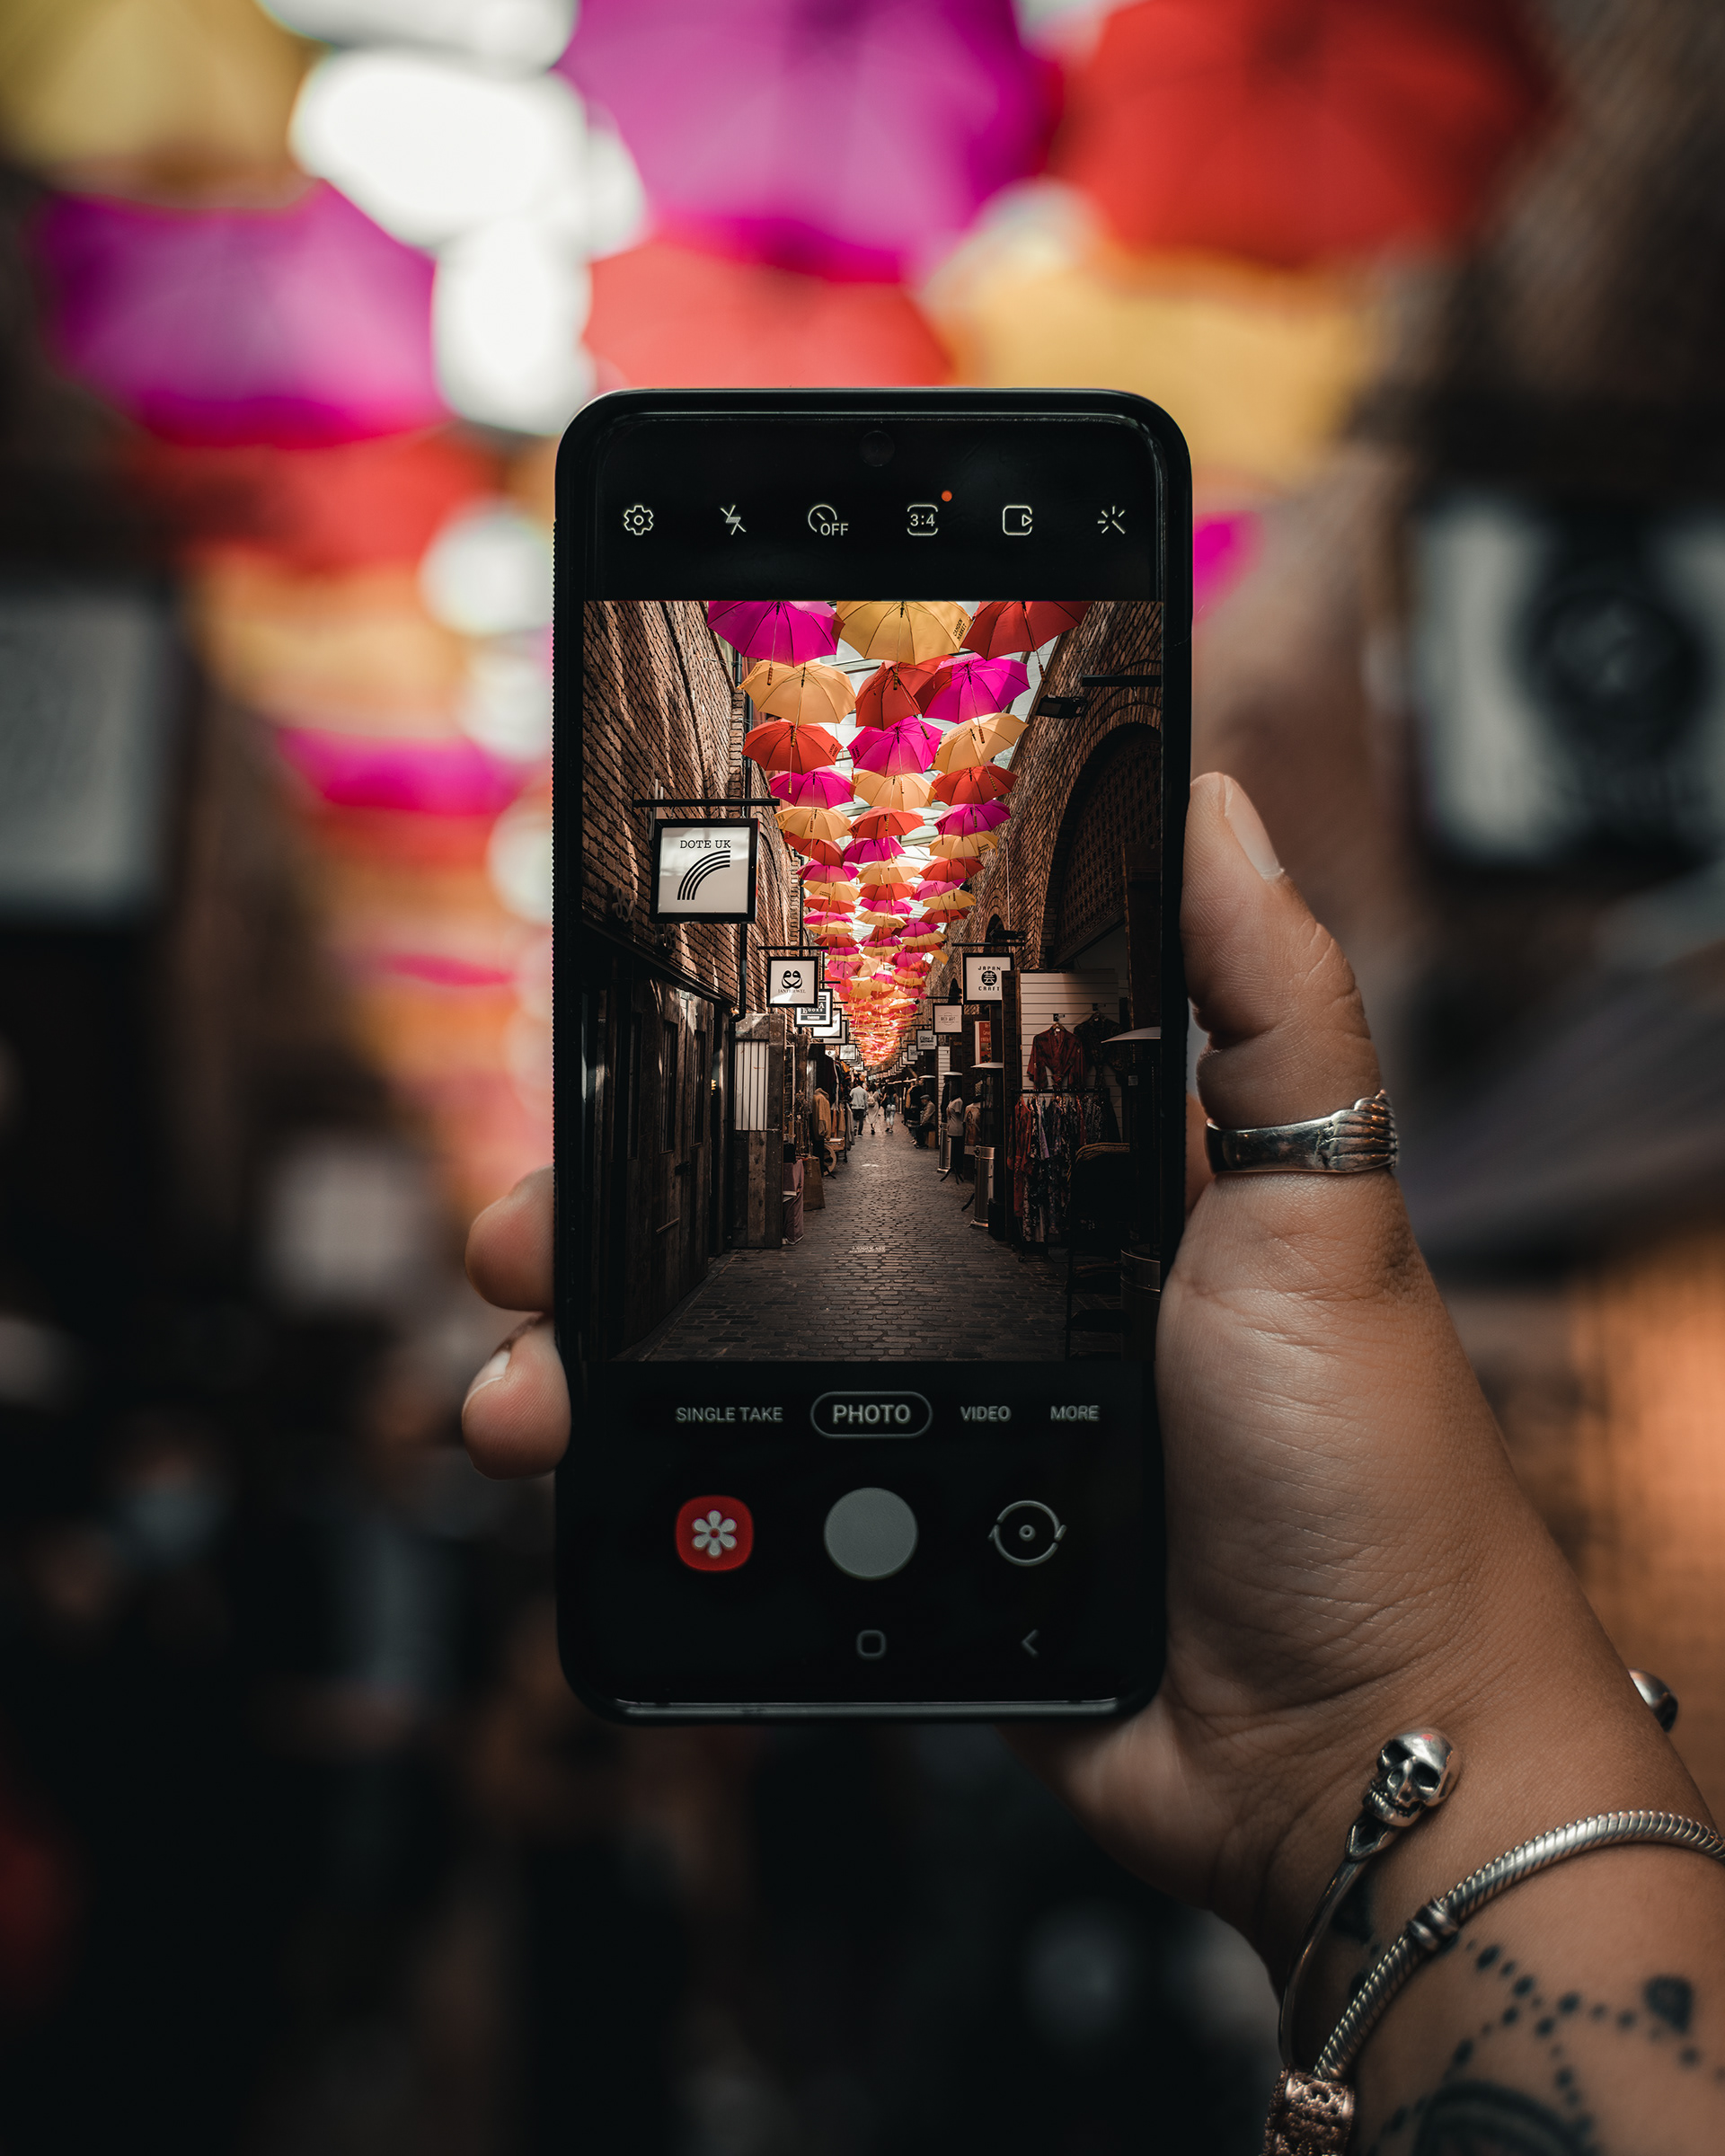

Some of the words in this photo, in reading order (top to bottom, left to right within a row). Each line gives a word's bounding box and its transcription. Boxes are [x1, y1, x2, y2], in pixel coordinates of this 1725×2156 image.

[910, 514, 935, 526] 3:4
[820, 523, 849, 536] OFF
[680, 840, 712, 849] DOTE
[714, 840, 731, 849] UK
[676, 1407, 736, 1422] SINGLE
[739, 1407, 783, 1422] TAKE
[832, 1404, 911, 1424] PHOTO
[960, 1405, 1012, 1422] VIDEO
[1050, 1405, 1101, 1422] MORE
